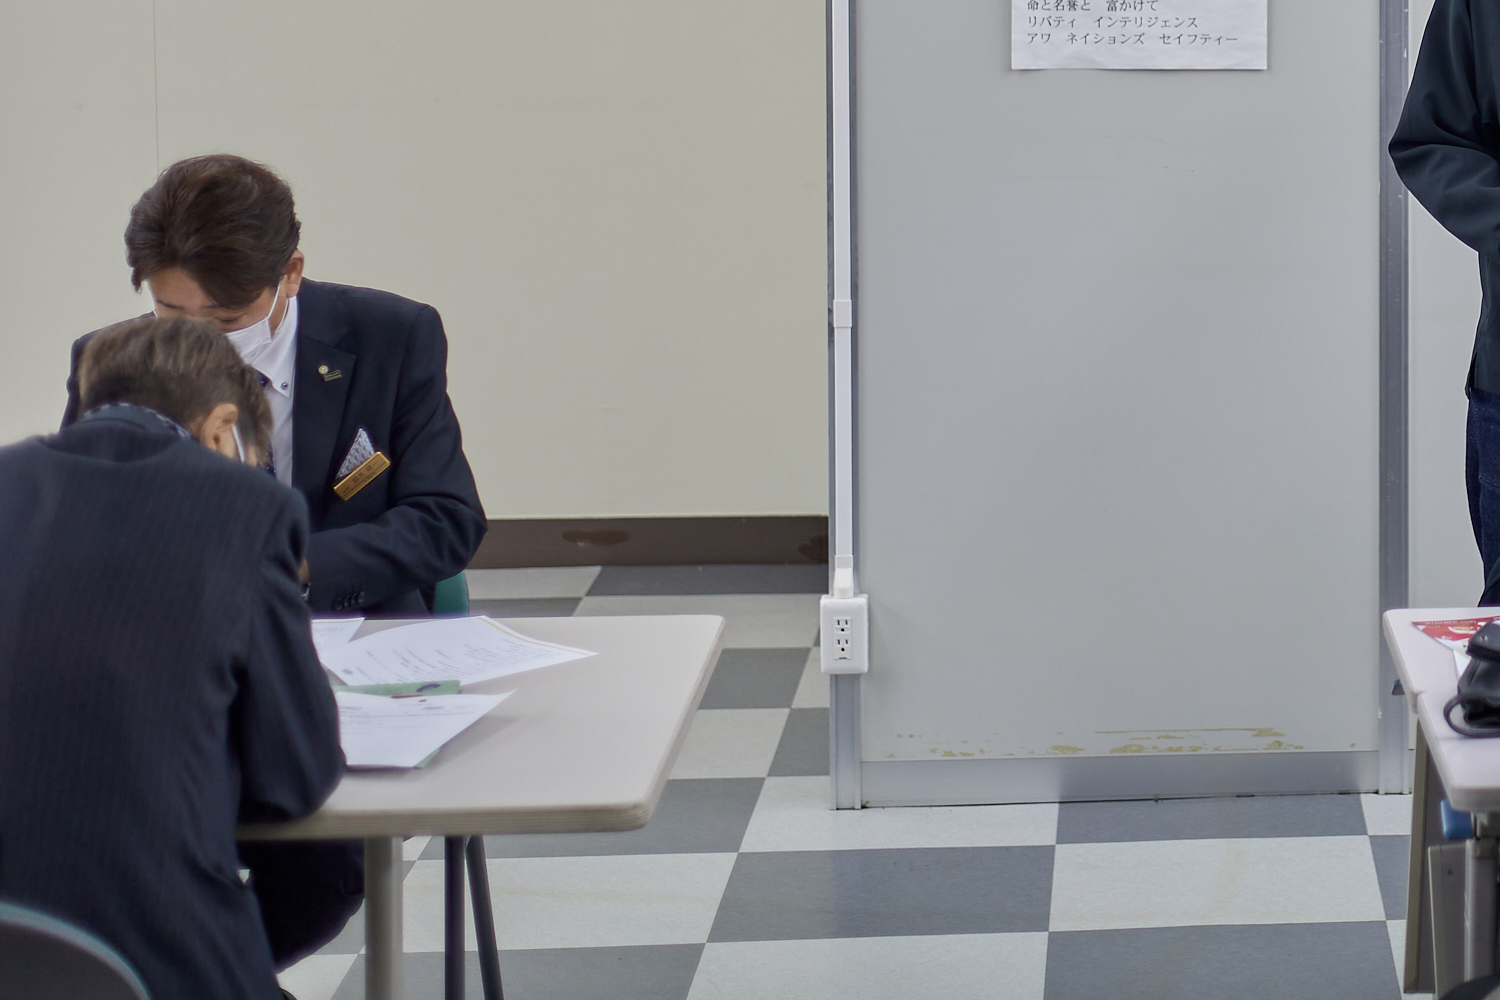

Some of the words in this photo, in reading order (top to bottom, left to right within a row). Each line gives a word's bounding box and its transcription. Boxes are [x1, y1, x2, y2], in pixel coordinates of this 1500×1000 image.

[1028, 15, 1076, 29] リバティ
[1094, 15, 1198, 29] インテリジェンス
[1027, 32, 1051, 45] アワ
[1066, 32, 1146, 45] ネイションズ
[1159, 33, 1238, 46] セイフティー
